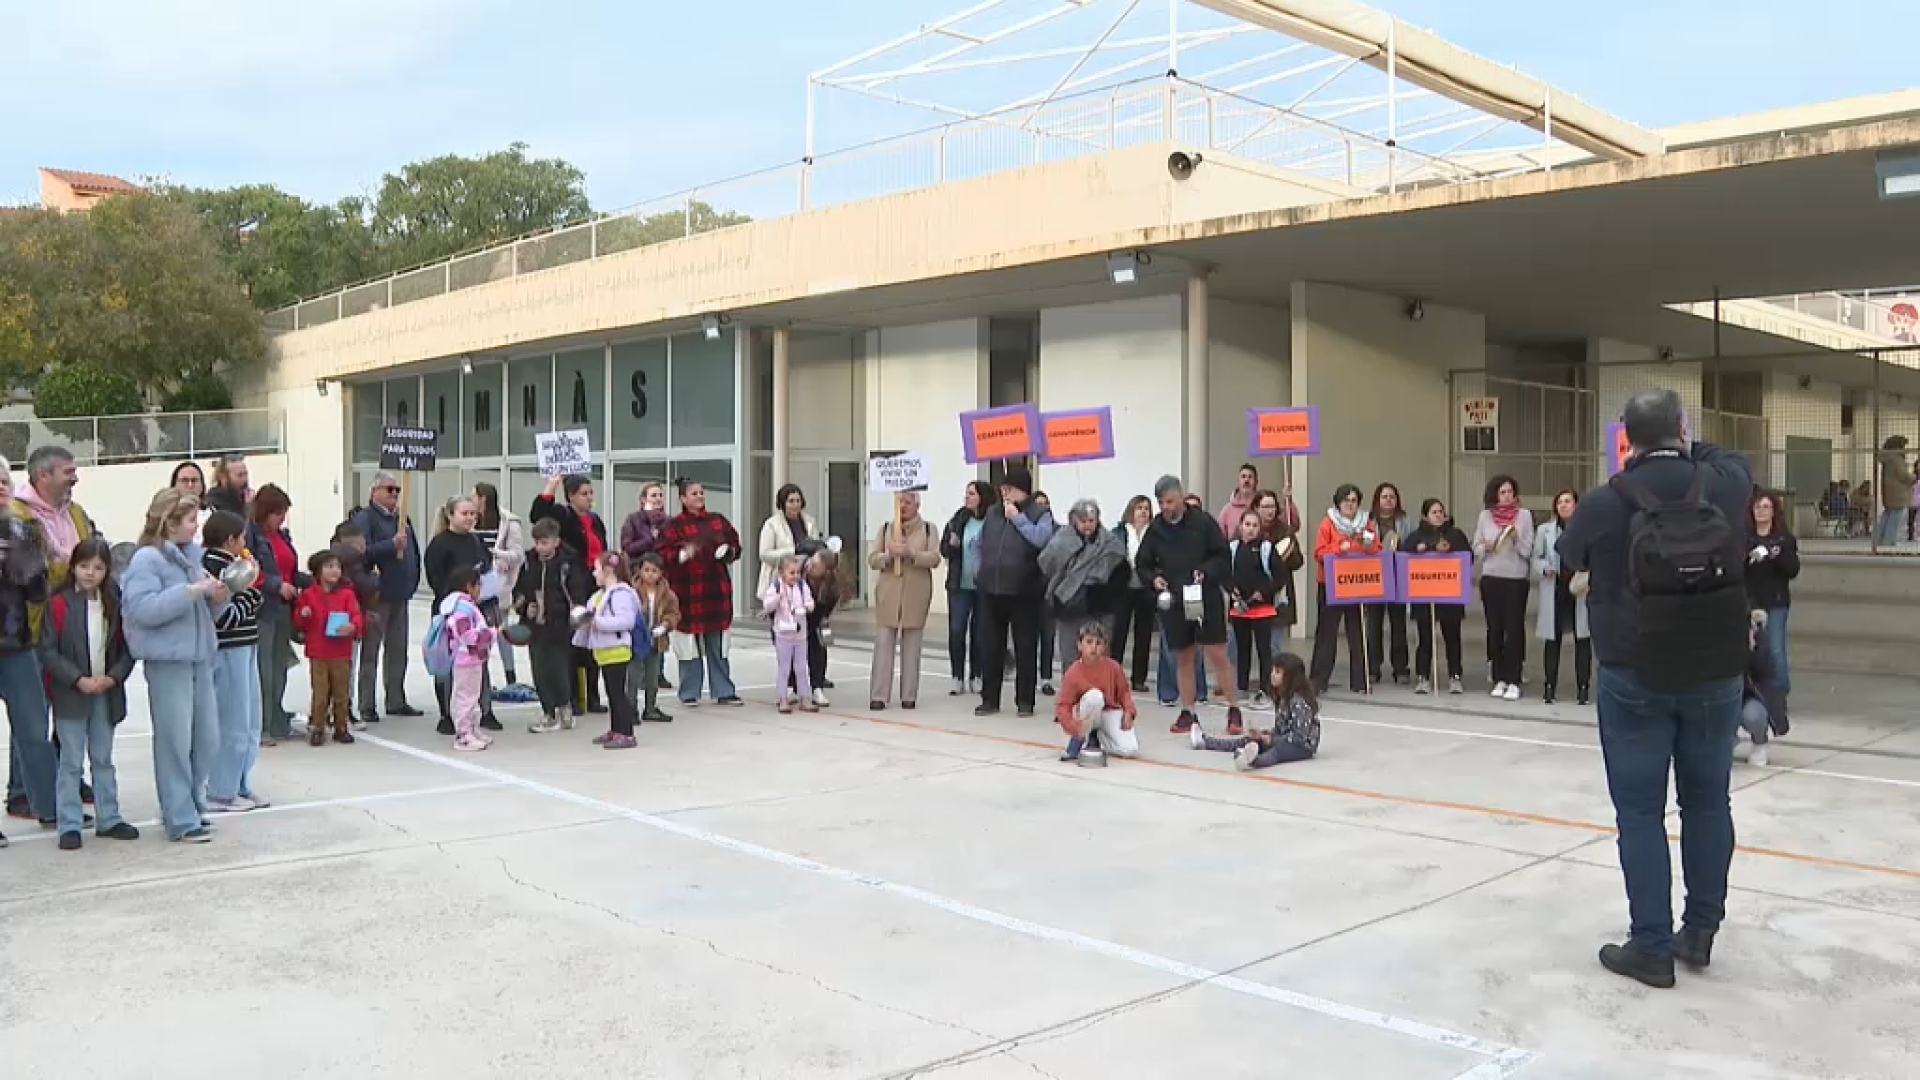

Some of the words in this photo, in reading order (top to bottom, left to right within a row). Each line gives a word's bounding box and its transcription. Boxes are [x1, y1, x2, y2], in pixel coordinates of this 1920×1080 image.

[385, 427, 434, 440] SEGURIDAD
[382, 443, 406, 454] PARA
[408, 445, 436, 456] TODOS
[541, 436, 584, 450] SEGURIDAD
[399, 456, 417, 469] YA!
[875, 458, 922, 469] QUEREMOS
[879, 469, 901, 478] VIVIR
[903, 468, 918, 477] SIN
[1336, 572, 1381, 585] CIVISME
[1410, 571, 1458, 581] SEGURETAT
